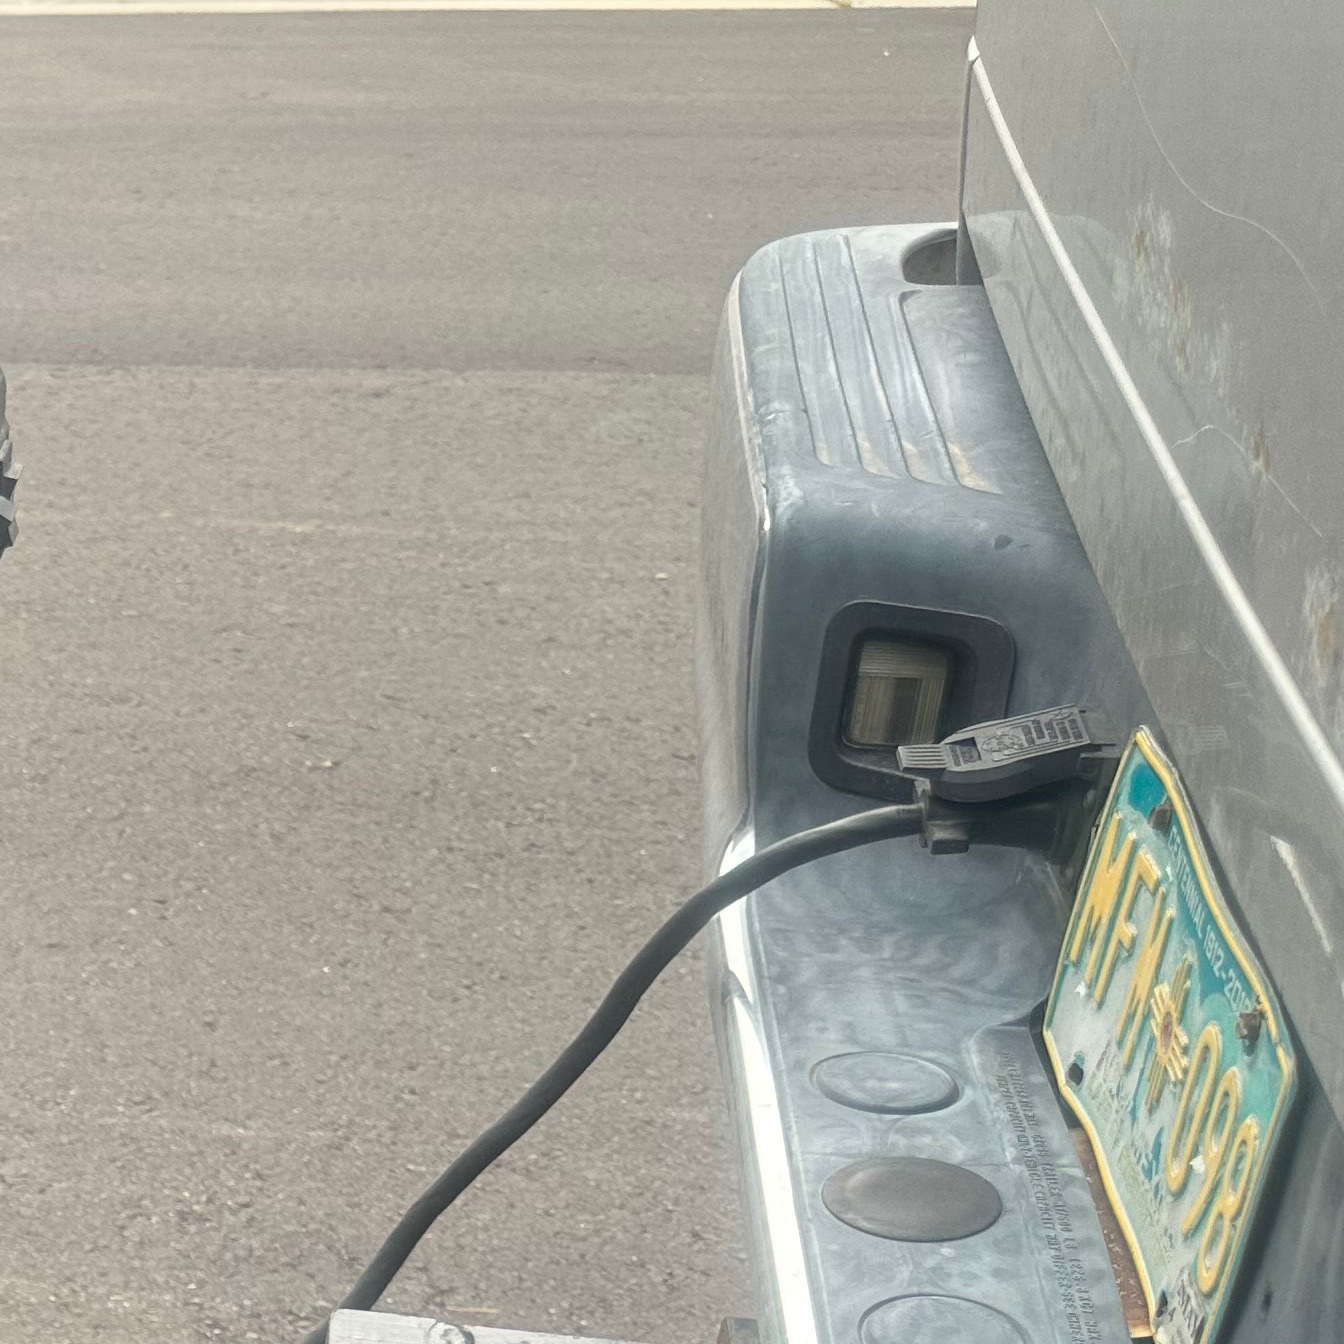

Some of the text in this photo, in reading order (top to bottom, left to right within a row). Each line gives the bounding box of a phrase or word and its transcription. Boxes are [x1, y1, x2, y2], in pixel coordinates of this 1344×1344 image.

[1167, 823, 1206, 939] CENTENNIAL
[1068, 809, 1176, 1072] MFM
[1166, 1020, 1258, 1294] 098
